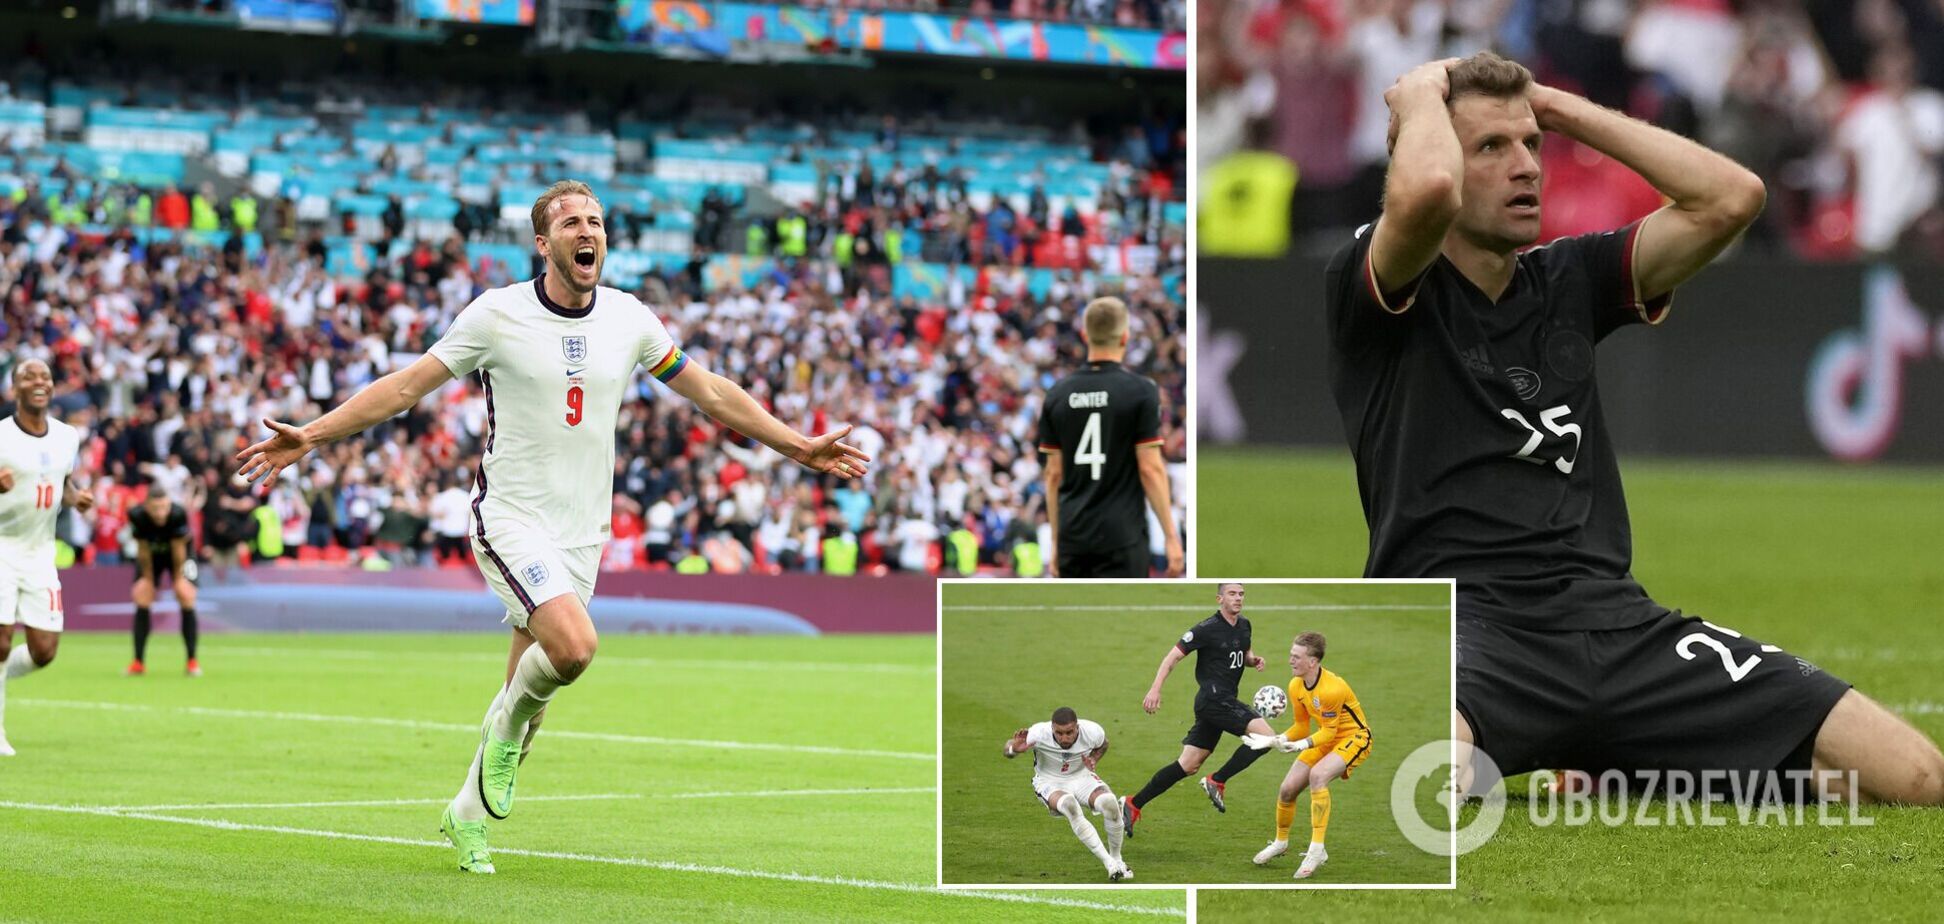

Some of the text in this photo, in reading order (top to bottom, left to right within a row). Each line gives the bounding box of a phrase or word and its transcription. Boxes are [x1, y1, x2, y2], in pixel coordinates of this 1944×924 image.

[565, 386, 584, 427] 9
[1068, 390, 1109, 409] GINTER
[1074, 412, 1107, 480] 4
[1501, 404, 1582, 474] 25
[35, 484, 54, 510] 10
[1229, 650, 1244, 669] 20
[1060, 762, 1070, 773] 2
